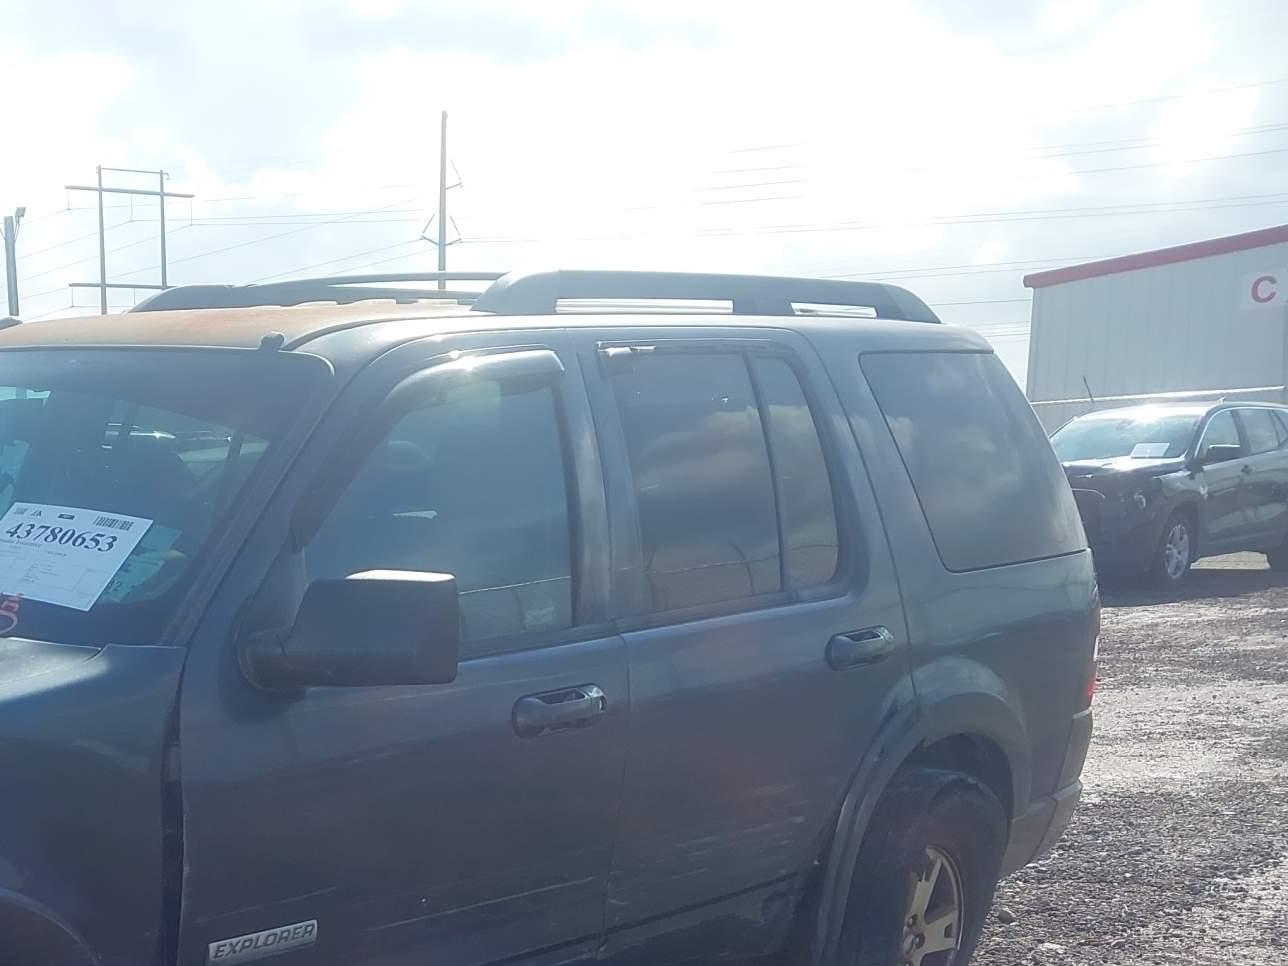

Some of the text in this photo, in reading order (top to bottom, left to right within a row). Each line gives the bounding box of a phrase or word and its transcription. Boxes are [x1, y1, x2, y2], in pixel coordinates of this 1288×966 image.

[1252, 275, 1277, 304] C
[6, 521, 118, 552] 43780653
[214, 923, 316, 959] EXPLORER
